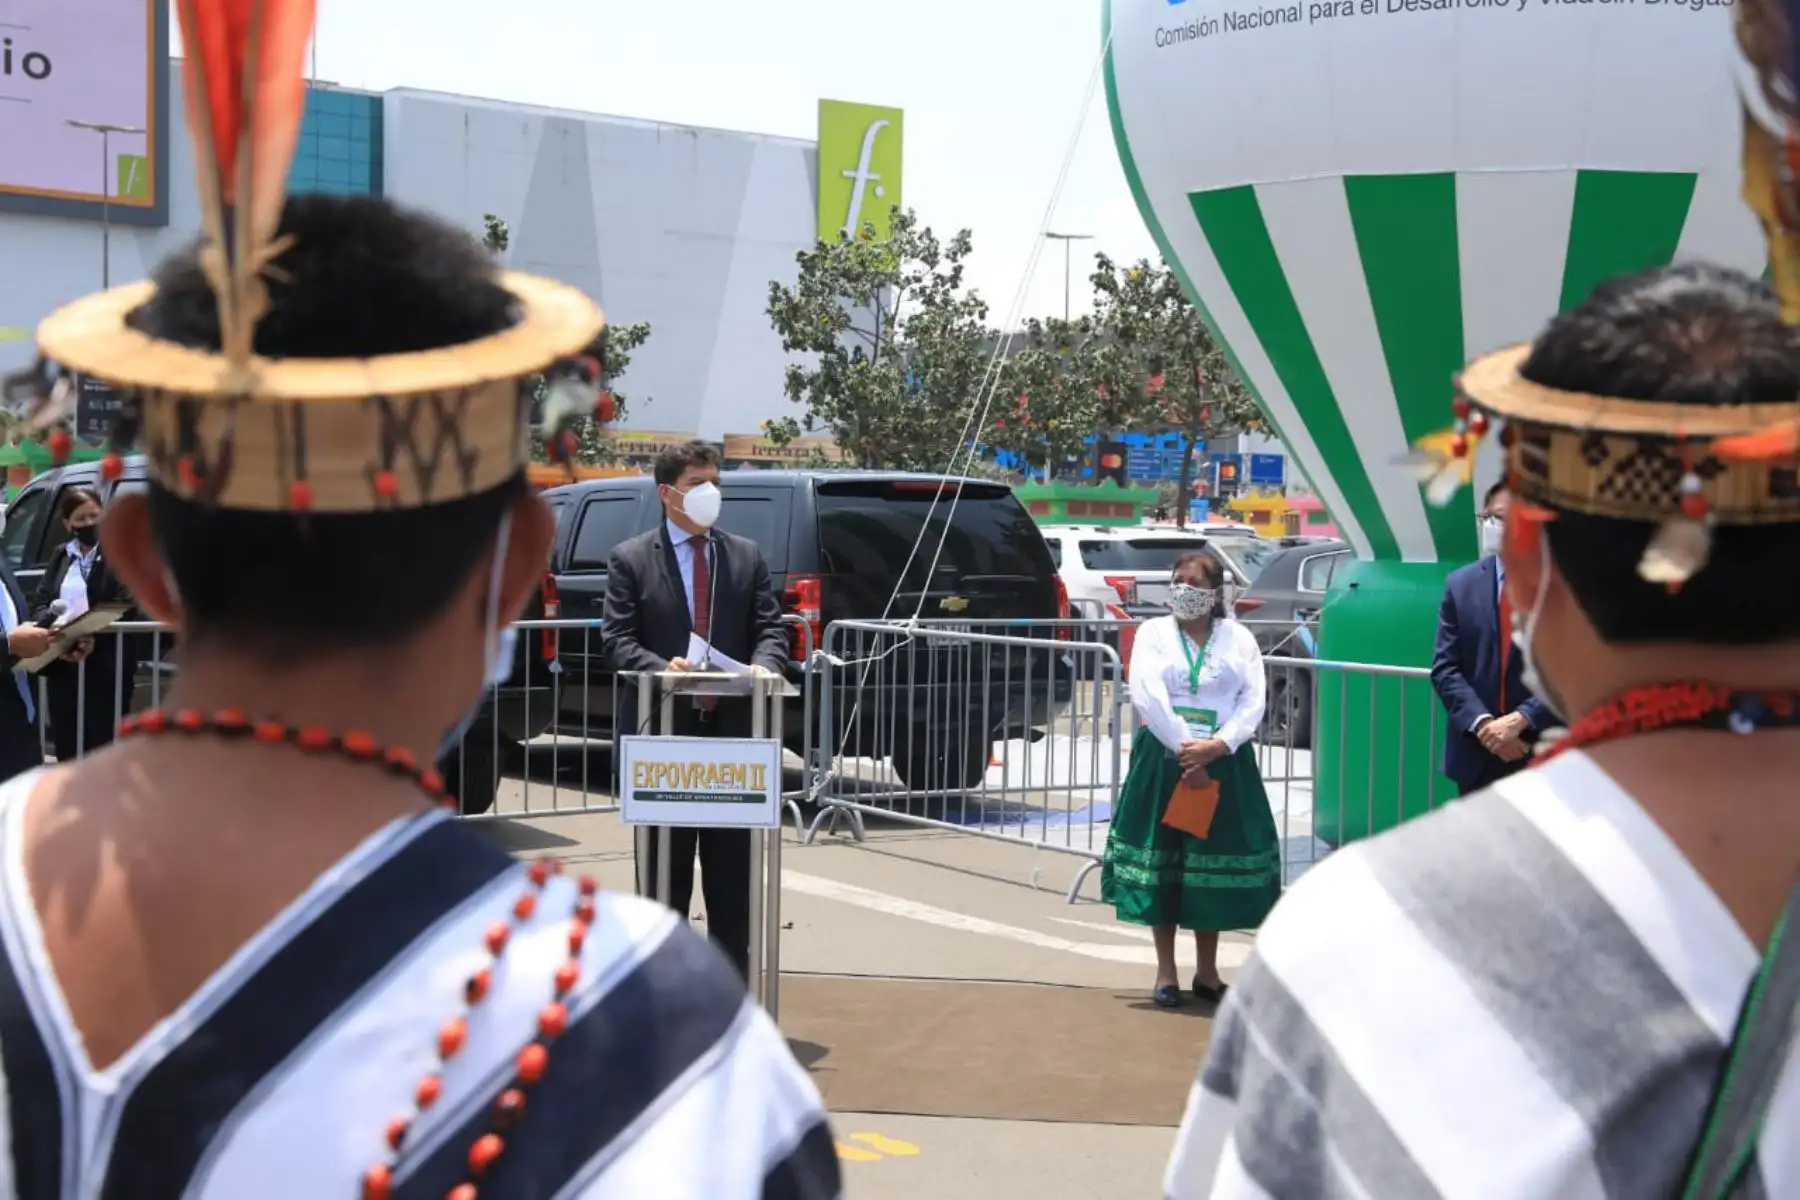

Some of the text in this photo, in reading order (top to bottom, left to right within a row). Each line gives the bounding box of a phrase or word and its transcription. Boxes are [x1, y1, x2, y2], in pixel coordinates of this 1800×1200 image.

[1155, 16, 1219, 48] Comisión
[1223, 3, 1302, 32] Nacional
[1309, 0, 1354, 24] para
[1360, 0, 1379, 14] el
[633, 761, 747, 790] EXPOVRAEM
